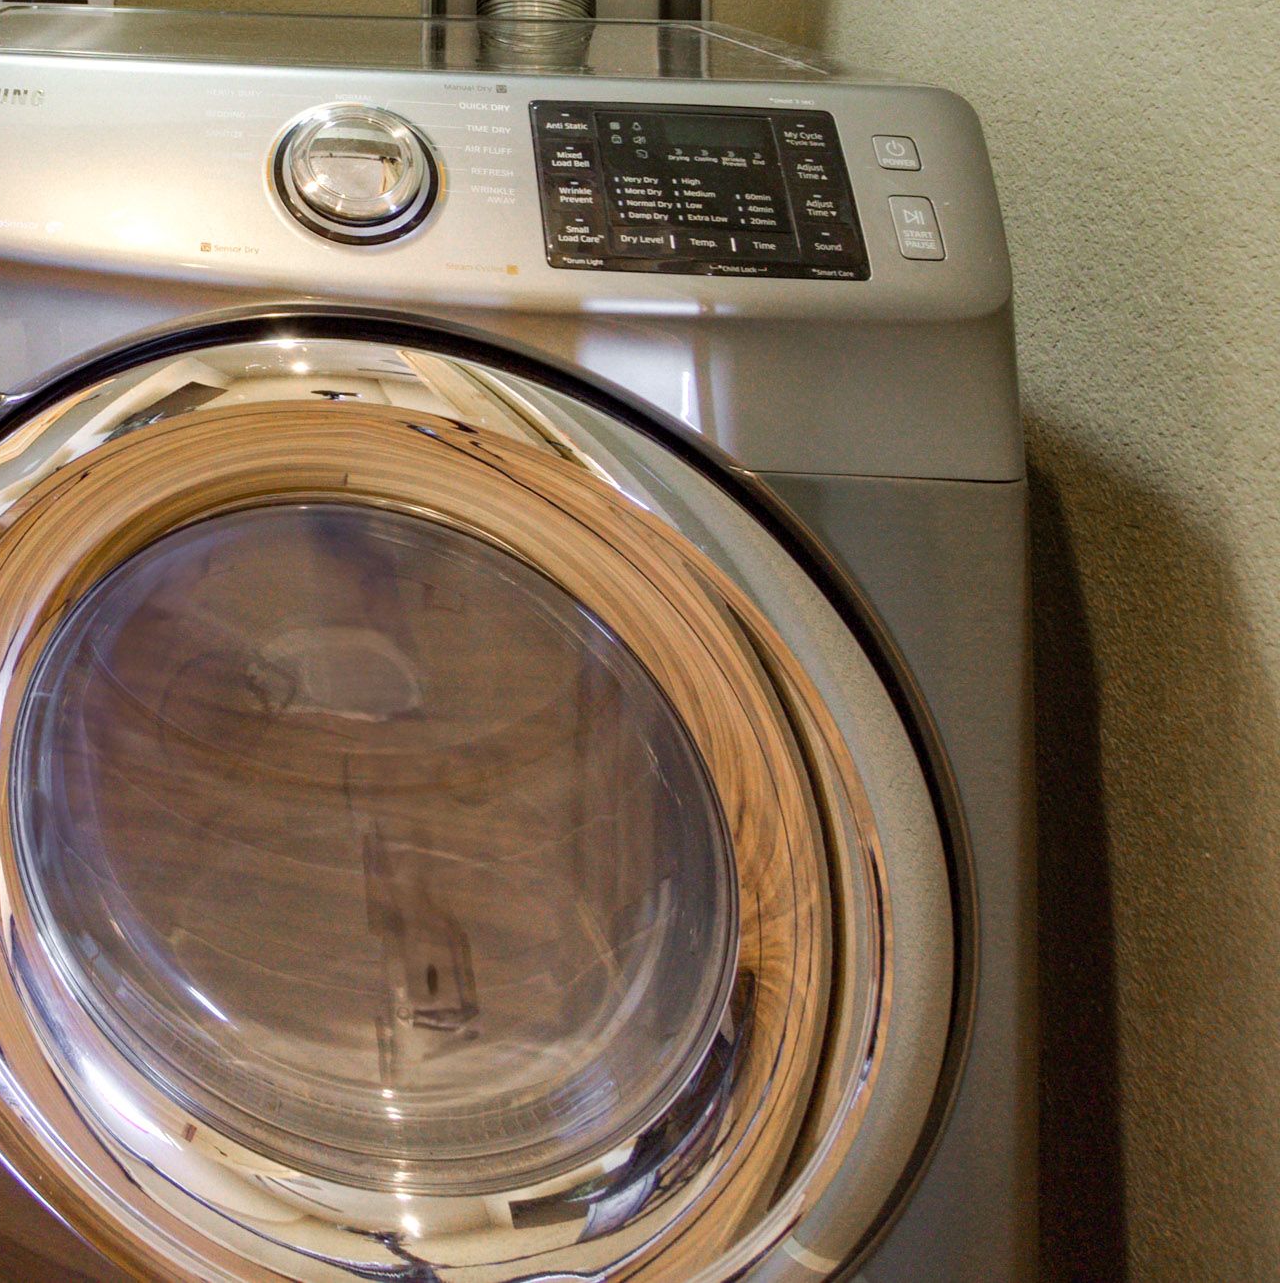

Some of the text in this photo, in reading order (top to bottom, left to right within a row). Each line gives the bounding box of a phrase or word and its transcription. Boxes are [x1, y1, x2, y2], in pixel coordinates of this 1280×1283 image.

[459, 102, 510, 112] QUICK DRY
[466, 124, 512, 135] TIME DRY
[546, 122, 588, 130] Anti Static
[784, 131, 823, 141] My Cycle
[464, 145, 513, 155] AIR FLUFF
[556, 151, 582, 159] Mixed
[551, 159, 572, 167] Load
[882, 158, 917, 167] POWER
[471, 168, 514, 177] REFRESH
[796, 164, 824, 173] Adjust
[622, 176, 659, 184] Very Dry
[798, 172, 820, 180] Time
[681, 178, 701, 186] High
[471, 185, 515, 196] WRINKLE
[558, 187, 592, 195] Wrinkle
[624, 187, 662, 196] More Dry
[683, 190, 716, 198] Medium
[487, 196, 516, 205] AWAY
[559, 196, 594, 204] Prevent
[745, 193, 772, 201] 60min
[626, 199, 673, 209] Normal Dry
[806, 200, 834, 209] Adjust
[628, 211, 669, 221] Damp Dry
[807, 209, 829, 217] Time
[688, 214, 728, 223] Extra Low
[750, 218, 777, 226] 20min
[565, 225, 589, 234] Small
[903, 230, 934, 239] START
[620, 235, 664, 244] Dry Level
[690, 238, 718, 248] Temp.
[752, 241, 777, 250] Time
[814, 242, 843, 251] Sound
[904, 240, 937, 250] PAUSE
[214, 245, 260, 255] Sensor Dry
[586, 258, 604, 266] Light
